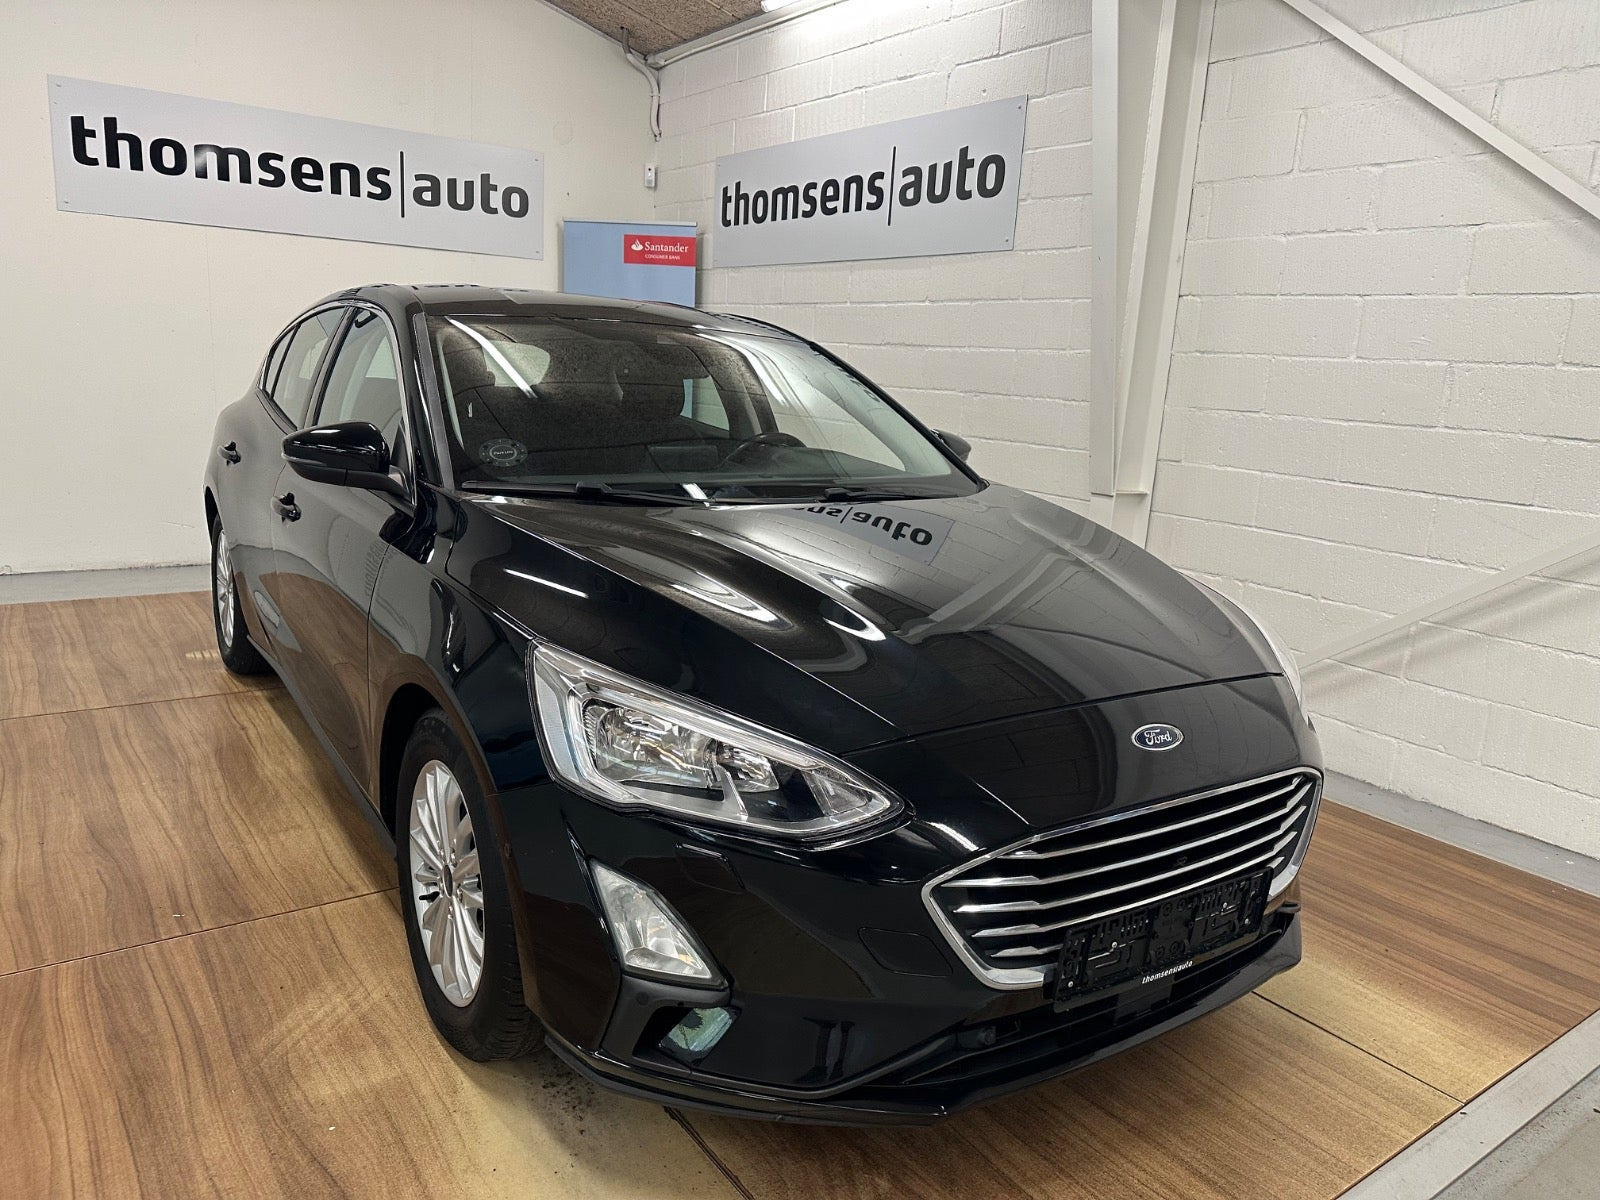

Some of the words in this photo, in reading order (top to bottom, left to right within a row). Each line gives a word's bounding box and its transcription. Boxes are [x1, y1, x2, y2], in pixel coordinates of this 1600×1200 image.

[70, 115, 392, 201] thomsens
[412, 173, 529, 219] auto
[721, 171, 885, 228] thomsens
[898, 145, 1006, 208] auto
[644, 241, 689, 252] Santander
[1144, 729, 1173, 746] Ford
